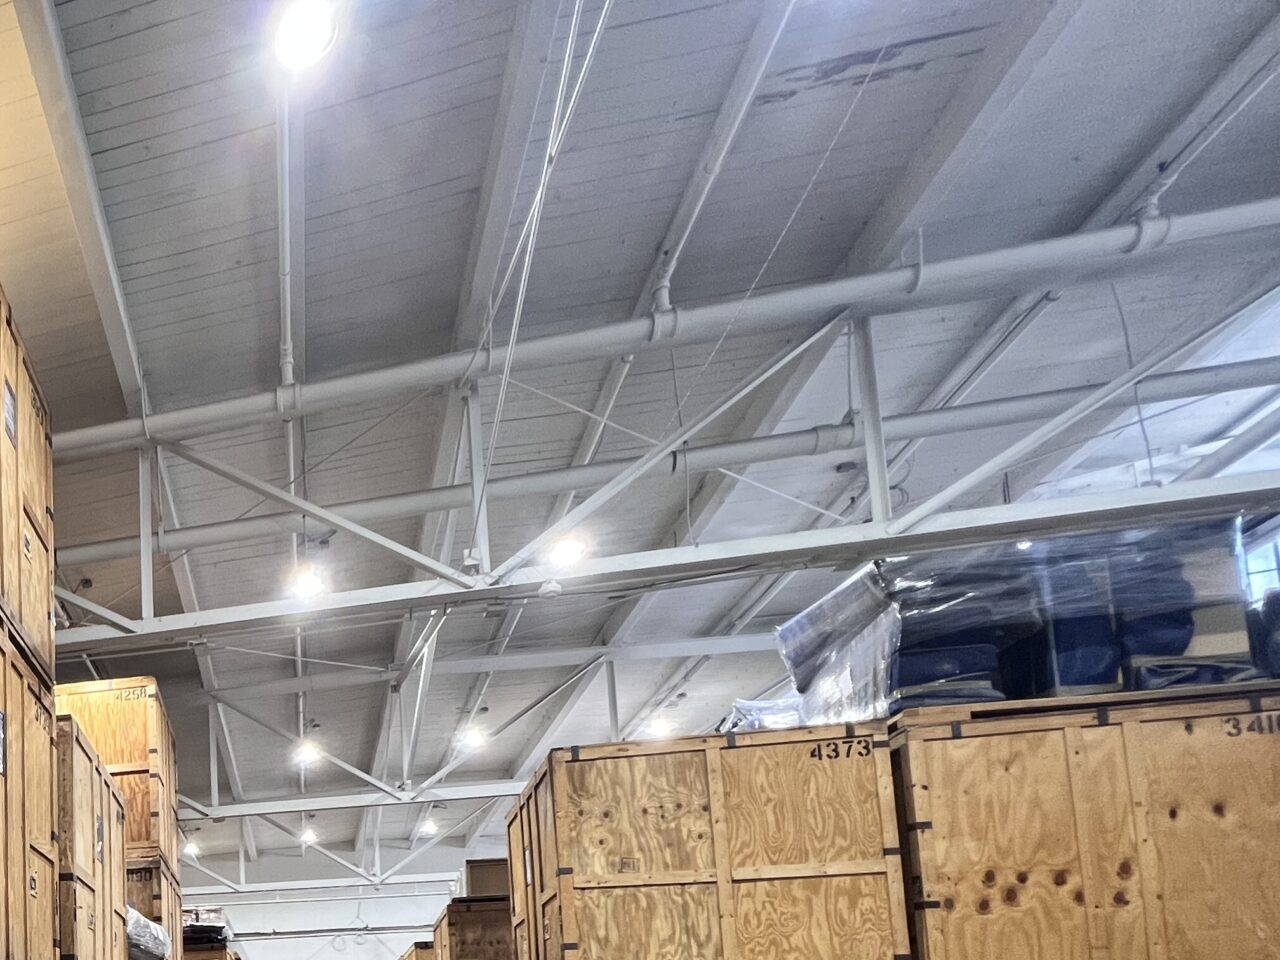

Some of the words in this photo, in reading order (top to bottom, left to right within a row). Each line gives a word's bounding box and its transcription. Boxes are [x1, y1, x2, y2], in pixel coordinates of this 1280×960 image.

[115, 687, 147, 702] 4258
[1224, 715, 1280, 737] 341
[810, 739, 871, 760] 4373
